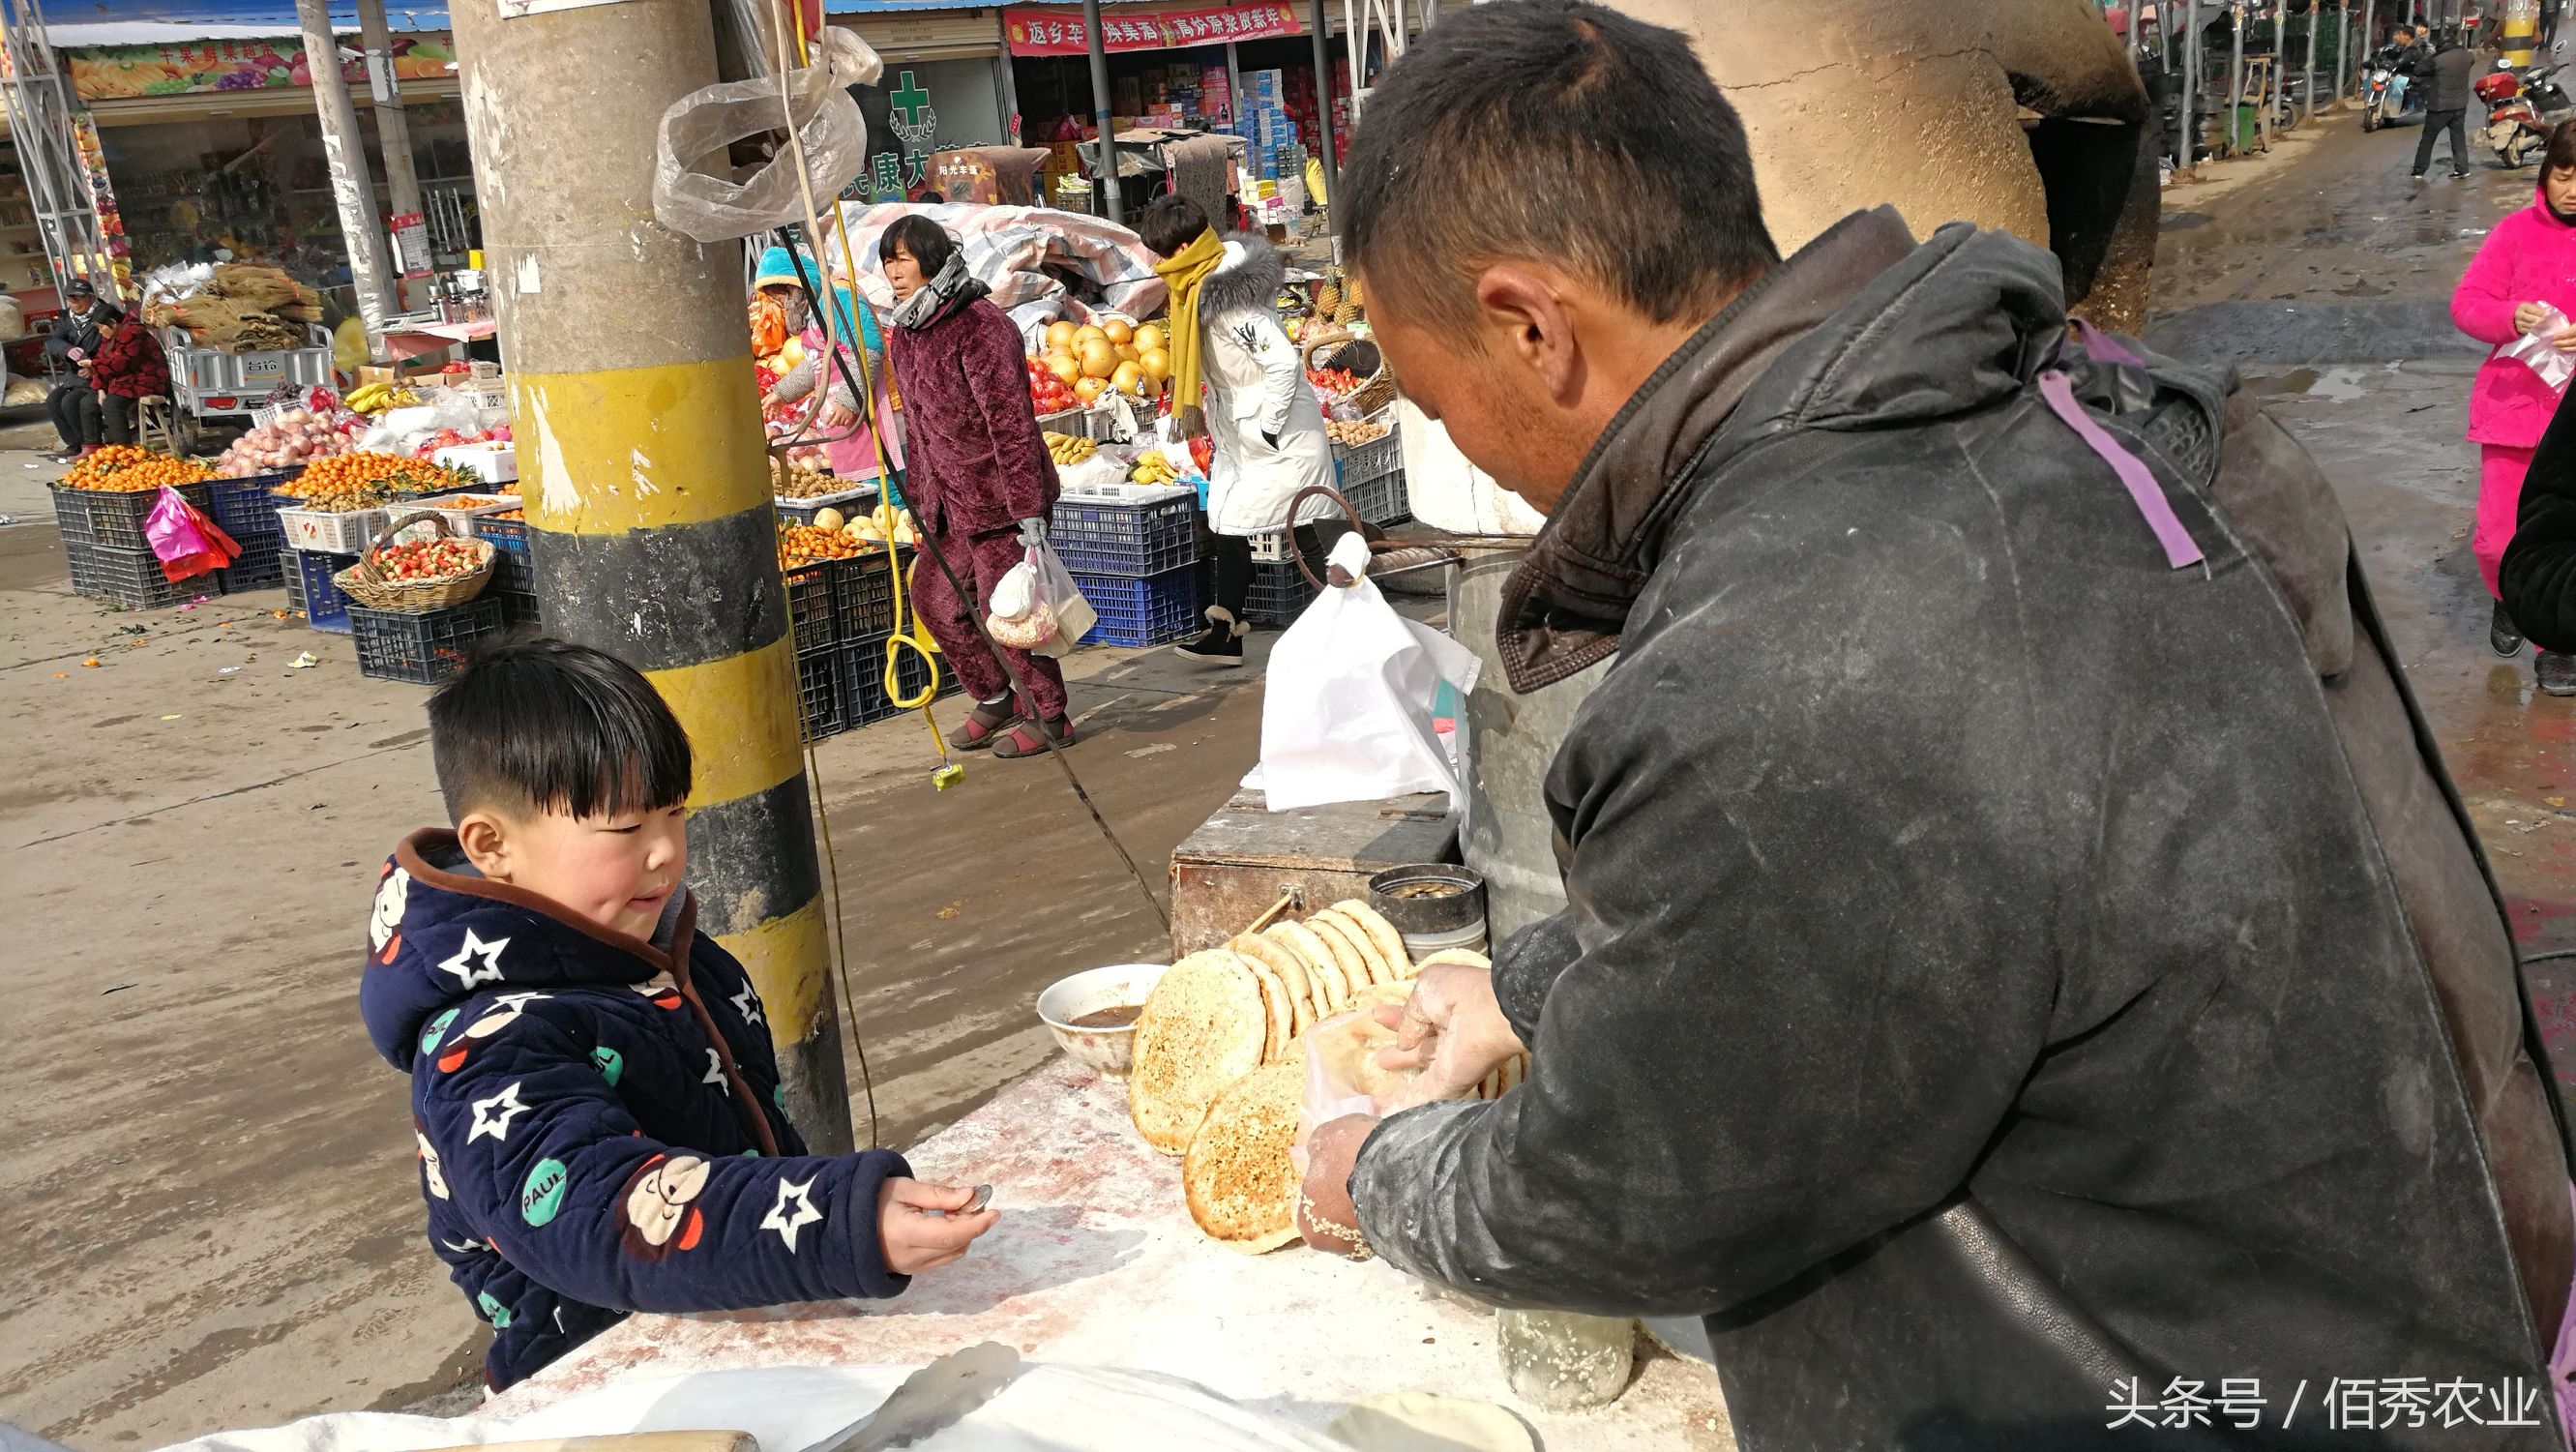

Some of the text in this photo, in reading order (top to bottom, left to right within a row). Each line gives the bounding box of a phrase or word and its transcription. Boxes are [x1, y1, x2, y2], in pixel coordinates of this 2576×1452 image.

[1026, 20, 1158, 44] 返乡车换美酒
[523, 1172, 565, 1213] PAUL
